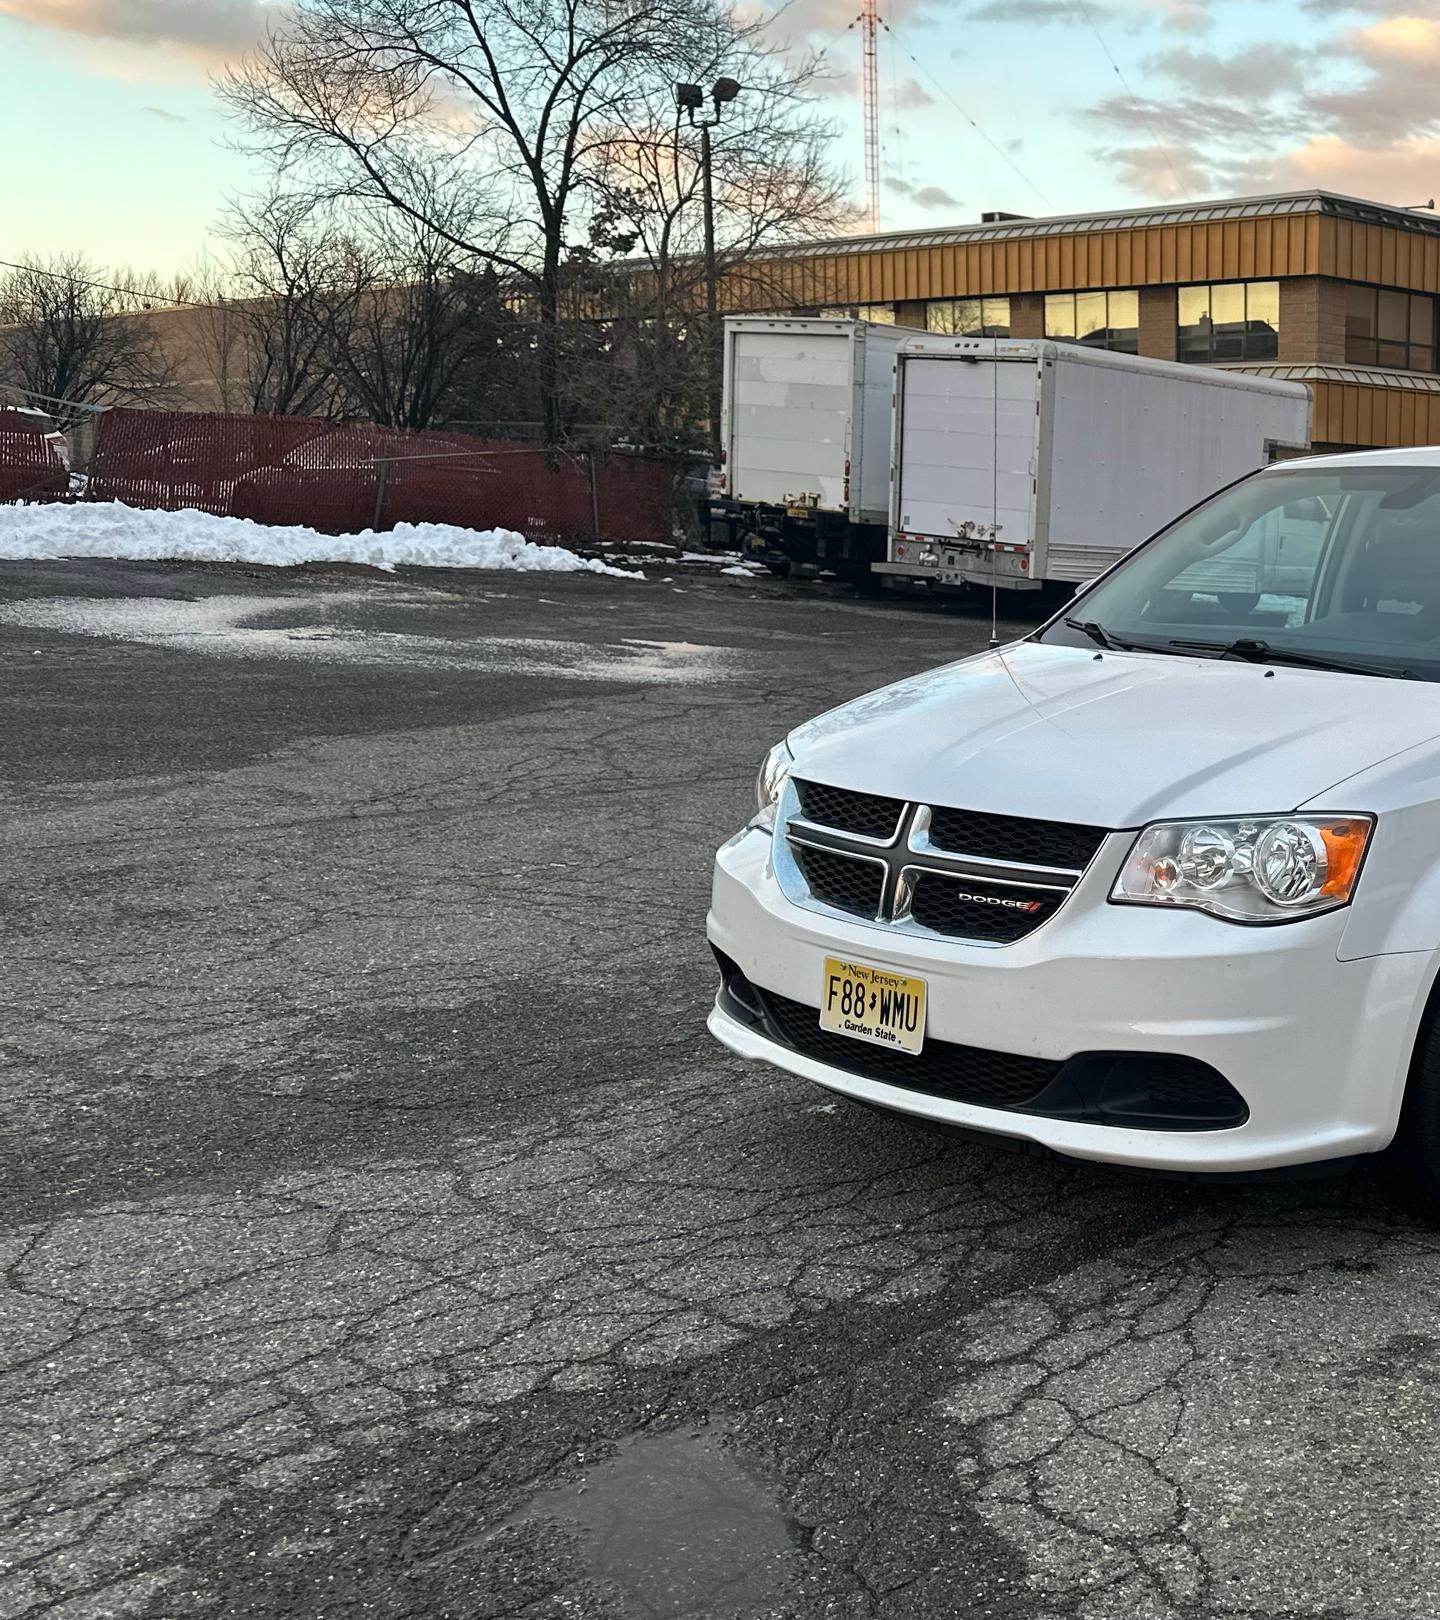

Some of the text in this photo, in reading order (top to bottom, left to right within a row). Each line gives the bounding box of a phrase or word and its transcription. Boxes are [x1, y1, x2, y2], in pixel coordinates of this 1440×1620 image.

[958, 893, 1030, 910] DODGE
[848, 964, 900, 990] New Jersey
[844, 1019, 897, 1042] Garden State
